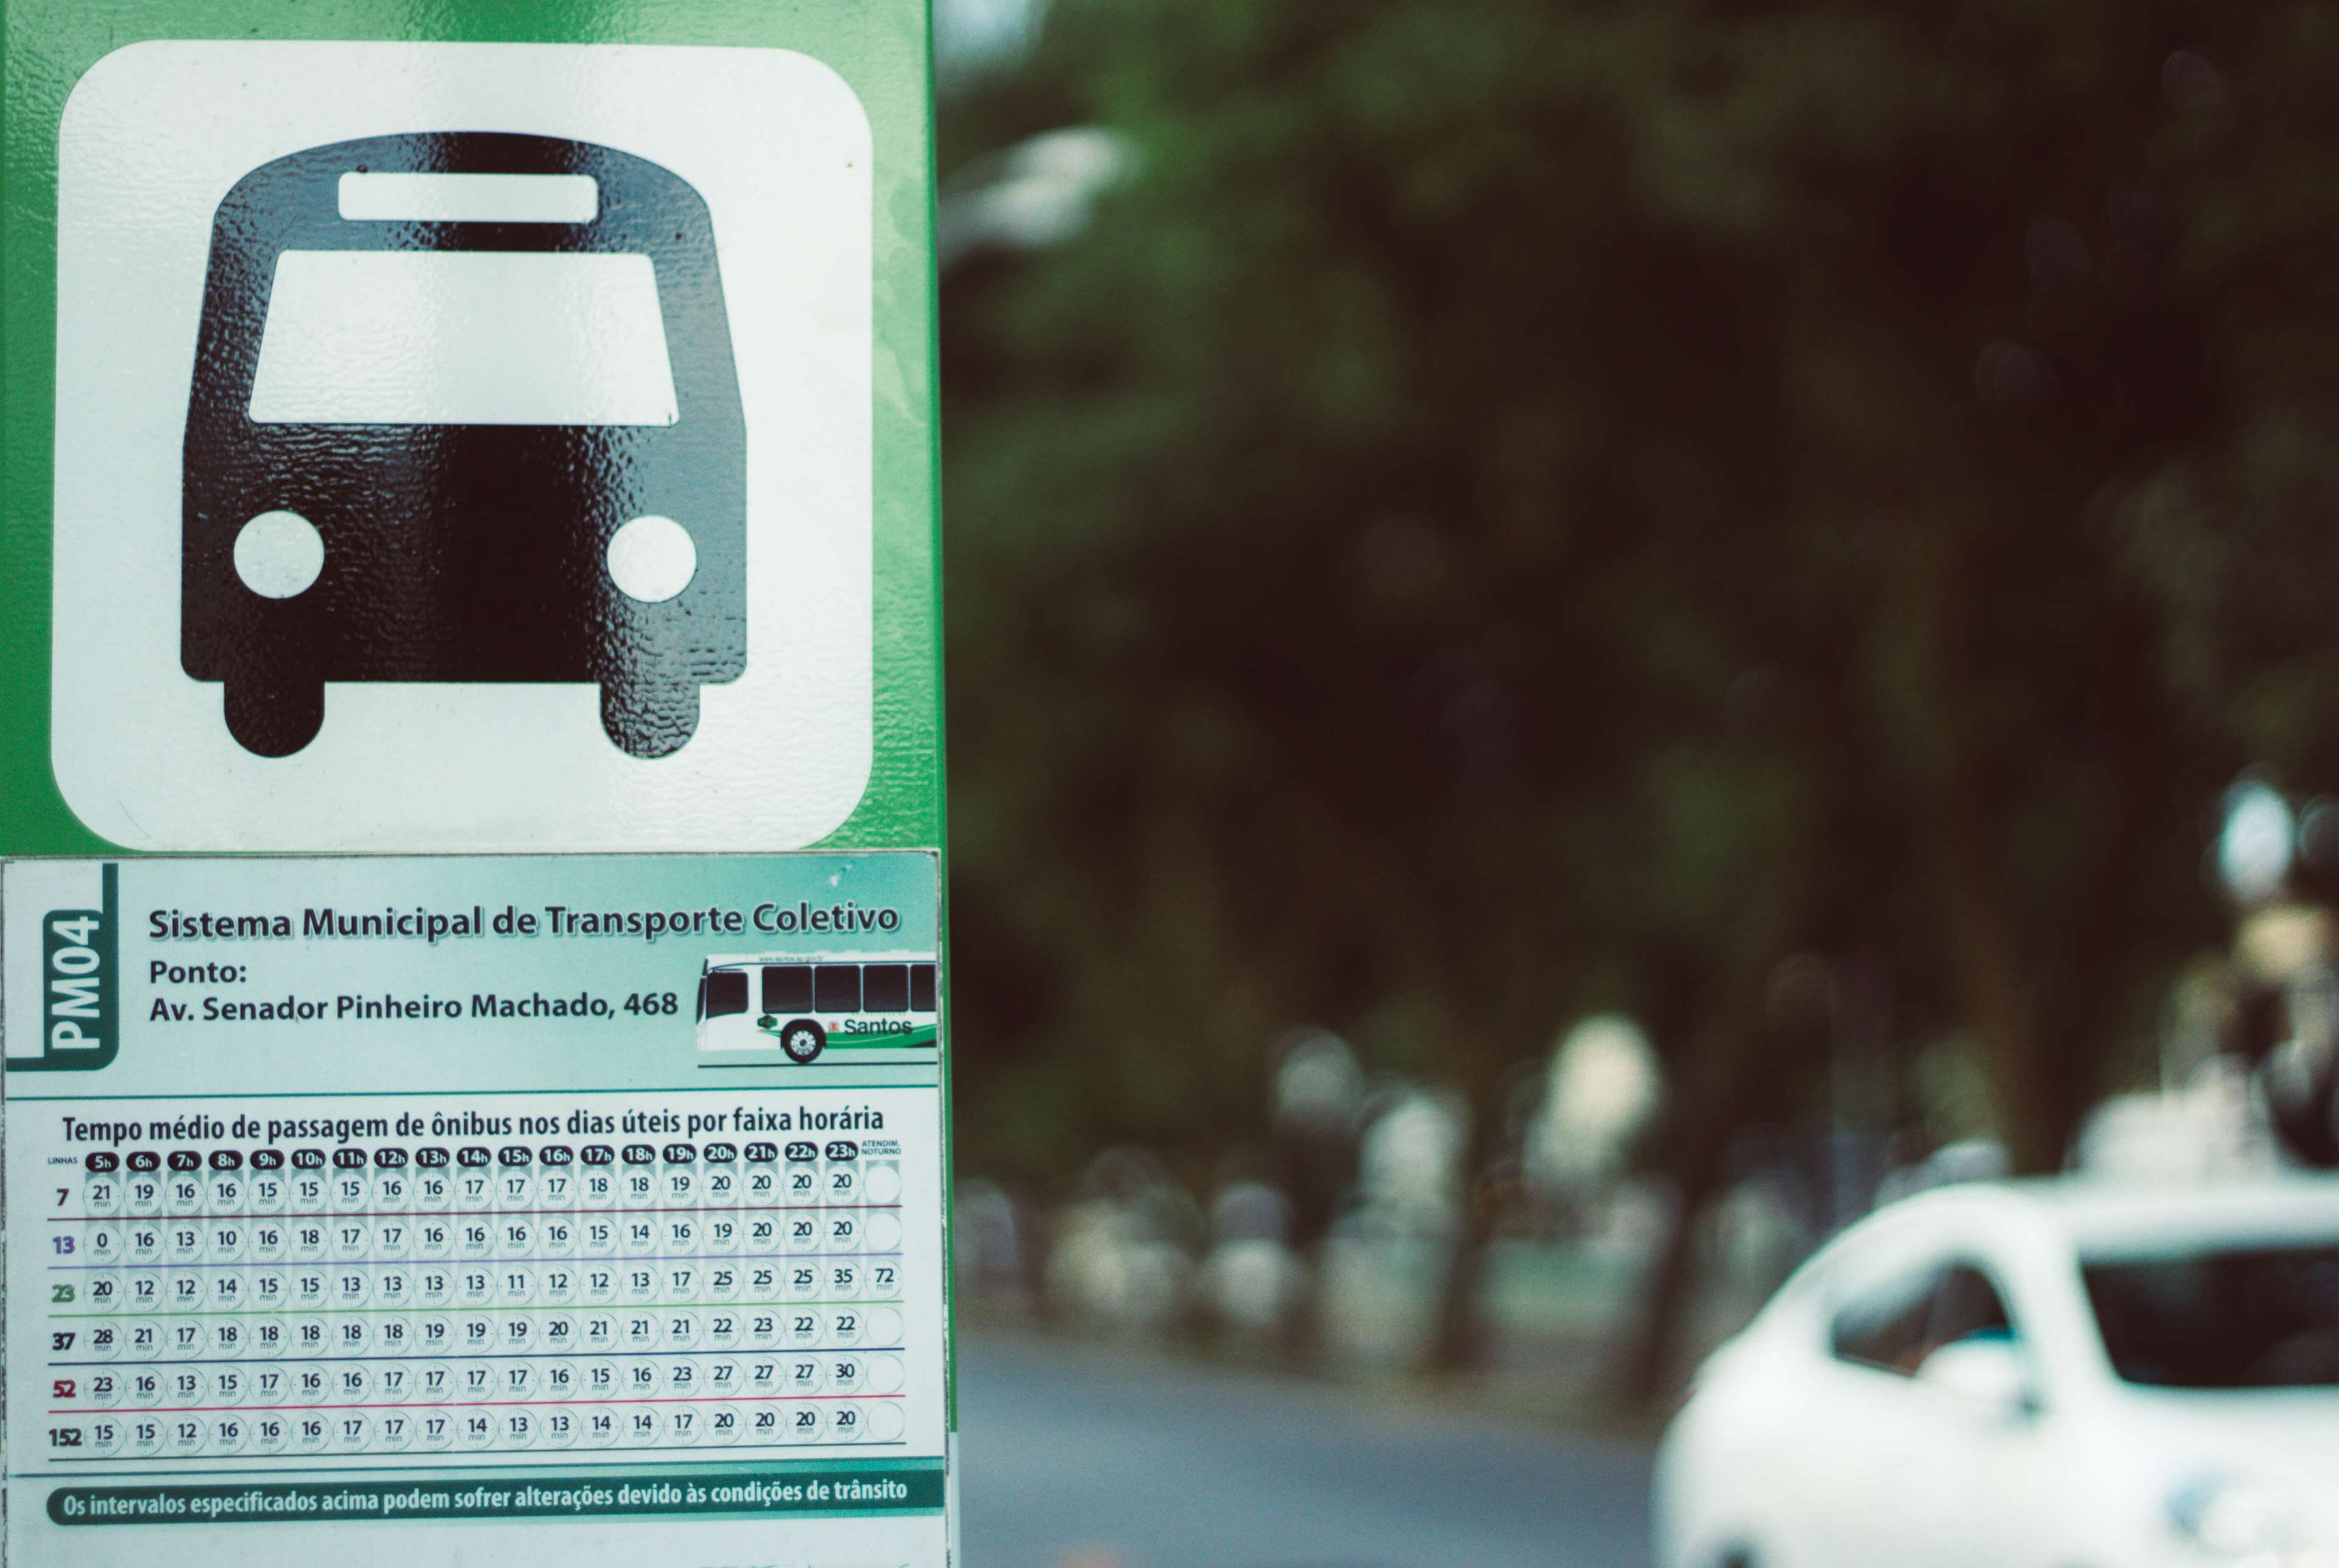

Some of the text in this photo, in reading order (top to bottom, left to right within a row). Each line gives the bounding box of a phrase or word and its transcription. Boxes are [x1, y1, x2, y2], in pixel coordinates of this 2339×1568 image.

[149, 902, 901, 943] Sistema Municipal de Transporte Coletivo
[51, 916, 100, 1049] PM04
[150, 960, 246, 984] Ponto:
[150, 992, 678, 1022] Av. Senador Pinheiro Machado, 468
[845, 1018, 913, 1035] Santos
[62, 1105, 883, 1148] Tempo médio de passagem de ônibus nos dias úteis por faixa horária
[95, 1155, 111, 1169] 5h
[135, 1154, 152, 1168] 6h
[177, 1154, 194, 1167] 7h
[217, 1153, 235, 1167] 8h
[259, 1153, 277, 1167] 9h
[297, 1152, 322, 1165] 10h
[338, 1151, 364, 1165] 11h
[379, 1151, 405, 1164] 12h
[421, 1150, 446, 1164] 13h
[462, 1150, 488, 1163] 14h
[503, 1149, 529, 1162] 15h
[545, 1149, 570, 1162] 16h
[586, 1148, 612, 1161] 17h
[627, 1147, 652, 1160] 18h
[668, 1146, 694, 1160] 19h
[708, 1146, 735, 1159] 20h
[748, 1145, 775, 1159] 21h
[789, 1145, 816, 1158] 22h
[829, 1144, 856, 1157] 23h
[57, 1174, 852, 1206] 7 21 19 16 16 15 15 15 16 16 17 17 17 18 18 19 20 20 20 20
[52, 1221, 852, 1254] 13 0 16 13 10 16 18 17 17 16 16 16 16 15 14 16 19 20 20 20
[51, 1268, 894, 1303] 23 20 12 12 14 15 15 13 13 13 13 11 12 12 13 17 25 25 25 35 72
[52, 1332, 76, 1351] 37
[53, 1380, 76, 1398] 52
[48, 1410, 856, 1447] 152 15 15 12 16 16 16 17 17 17 14 13 13 14 14 17 20 20 20 20
[64, 1478, 908, 1516] Os intervalos especificados acima podem sofrer alterações devido às condições de trânsito
